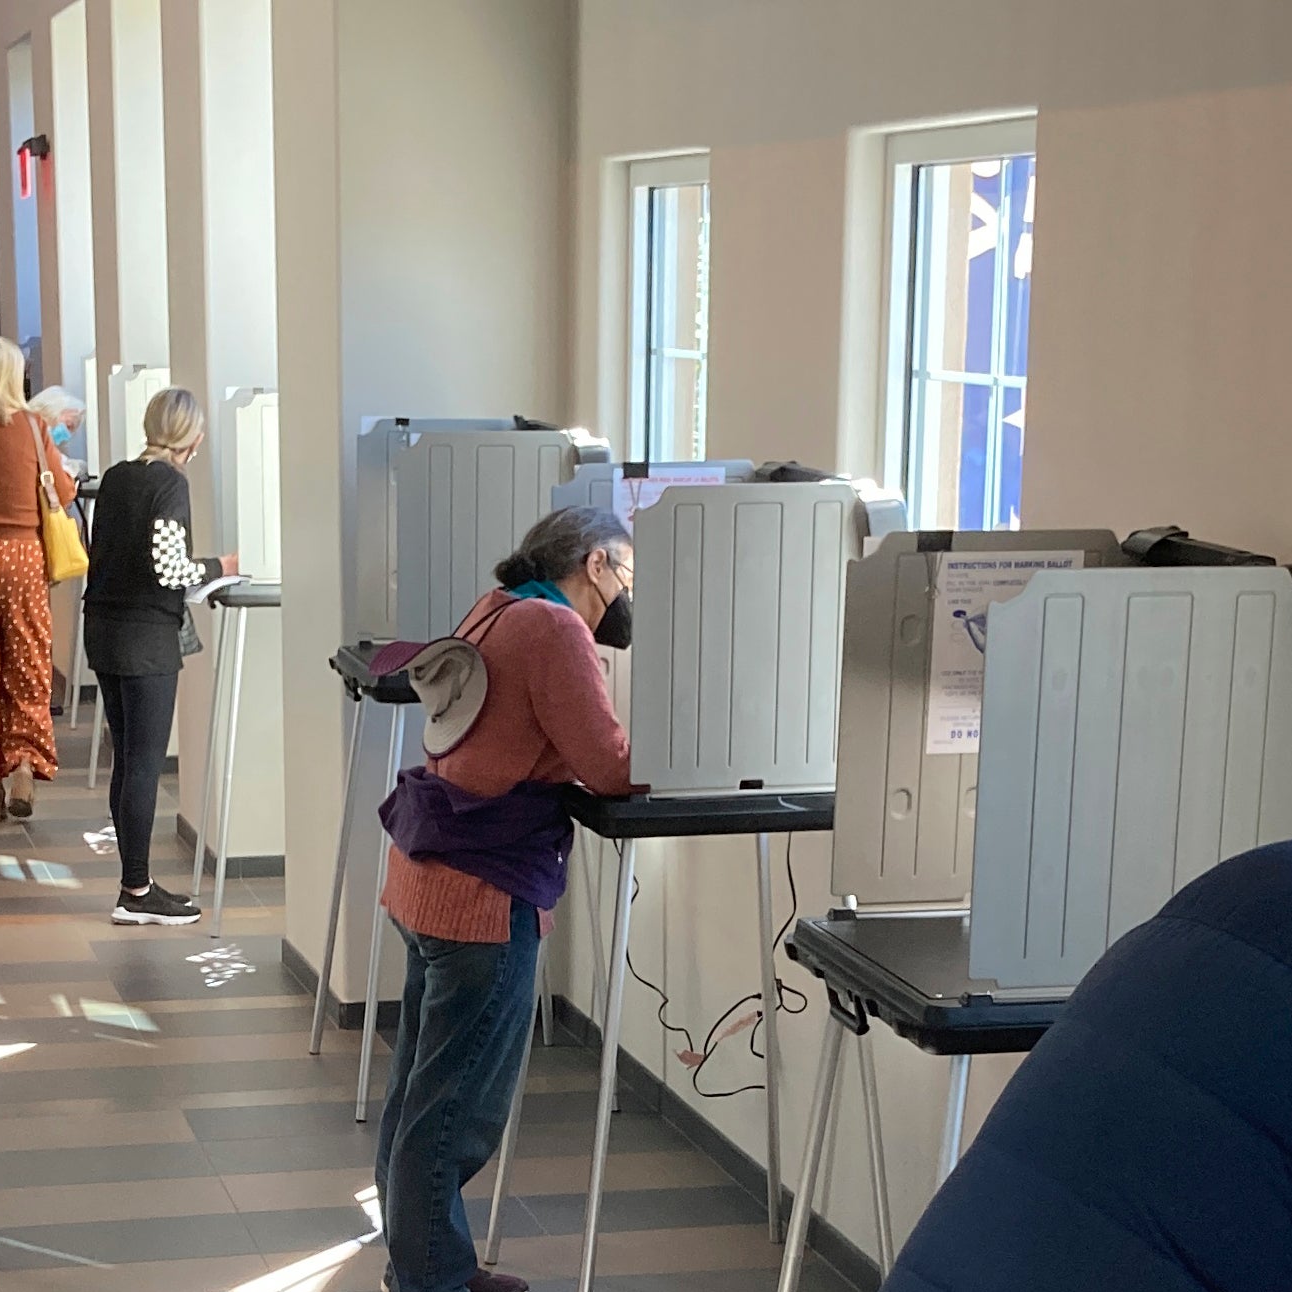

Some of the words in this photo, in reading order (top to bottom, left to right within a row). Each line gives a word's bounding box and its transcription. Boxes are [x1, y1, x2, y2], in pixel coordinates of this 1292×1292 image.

[948, 561, 997, 569] INSTRUCTIONS
[999, 561, 1012, 569] FOR
[1014, 560, 1045, 568] MARKING
[1047, 559, 1073, 568] BALLOT
[950, 730, 963, 738] DO
[966, 729, 979, 738] NO
